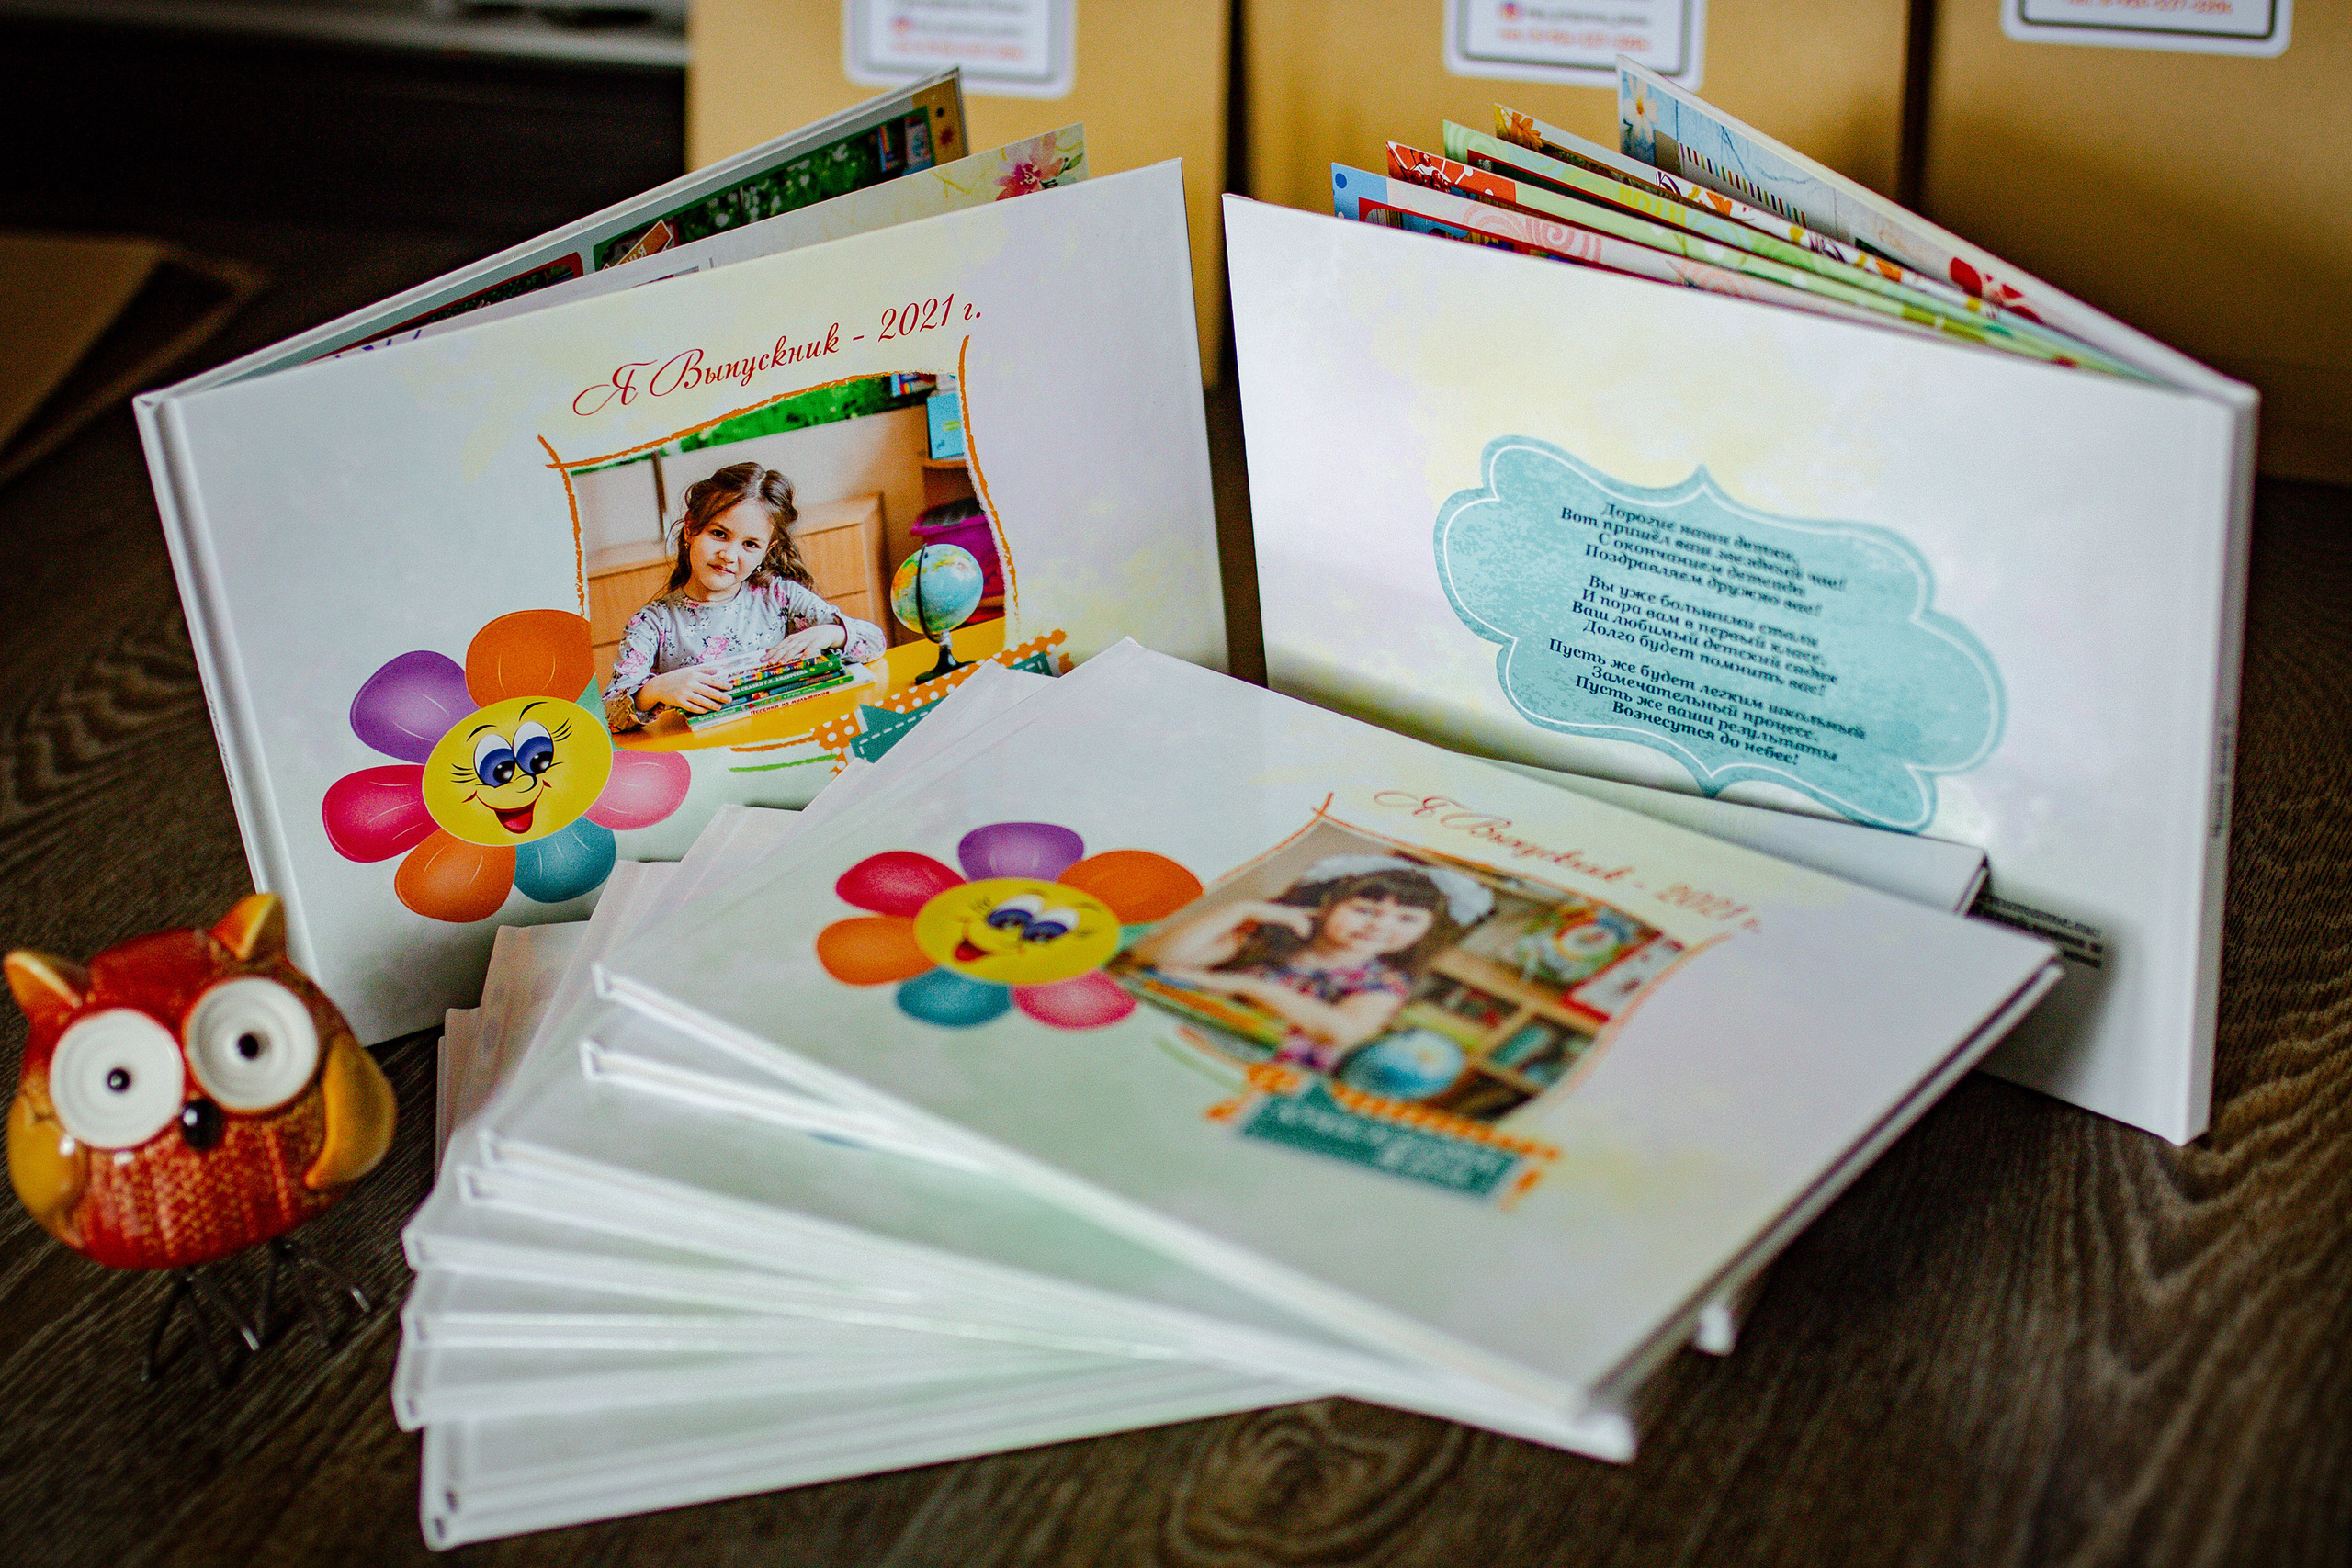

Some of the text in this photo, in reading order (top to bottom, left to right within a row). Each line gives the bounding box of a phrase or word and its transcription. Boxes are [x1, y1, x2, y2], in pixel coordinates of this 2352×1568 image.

[573, 359, 658, 415] Я
[650, 322, 840, 396] Выпускник
[878, 293, 955, 343] 2021
[963, 302, 981, 320] г.
[1561, 507, 1598, 527] Вот
[1603, 519, 1669, 545] пришёл
[1601, 502, 1675, 531] Дорогие
[1586, 544, 1702, 584] Поздравляем
[1707, 577, 1781, 605] дружно
[1599, 533, 1611, 545] С
[1614, 539, 1723, 574] окончанием
[1572, 601, 1609, 621] Ваш
[1613, 615, 1699, 647] любимый
[1703, 637, 1781, 669] детский
[1582, 589, 1596, 603] И
[1600, 596, 1641, 615] пора
[1646, 609, 1679, 626] вам
[1685, 619, 1693, 628] в
[1699, 623, 1765, 649] первый
[1589, 575, 1819, 649] Вы уже большими стали
[1583, 619, 1635, 643] Долго
[1639, 635, 1694, 660] будет
[1700, 654, 1784, 685] помнить
[1548, 638, 1866, 739] Пусть же будет легким школьный
[1576, 675, 1838, 761] Пусть же ваши результаты
[1592, 666, 1737, 718] Замечательный
[1612, 700, 1799, 765] Вознесутся до небес!
